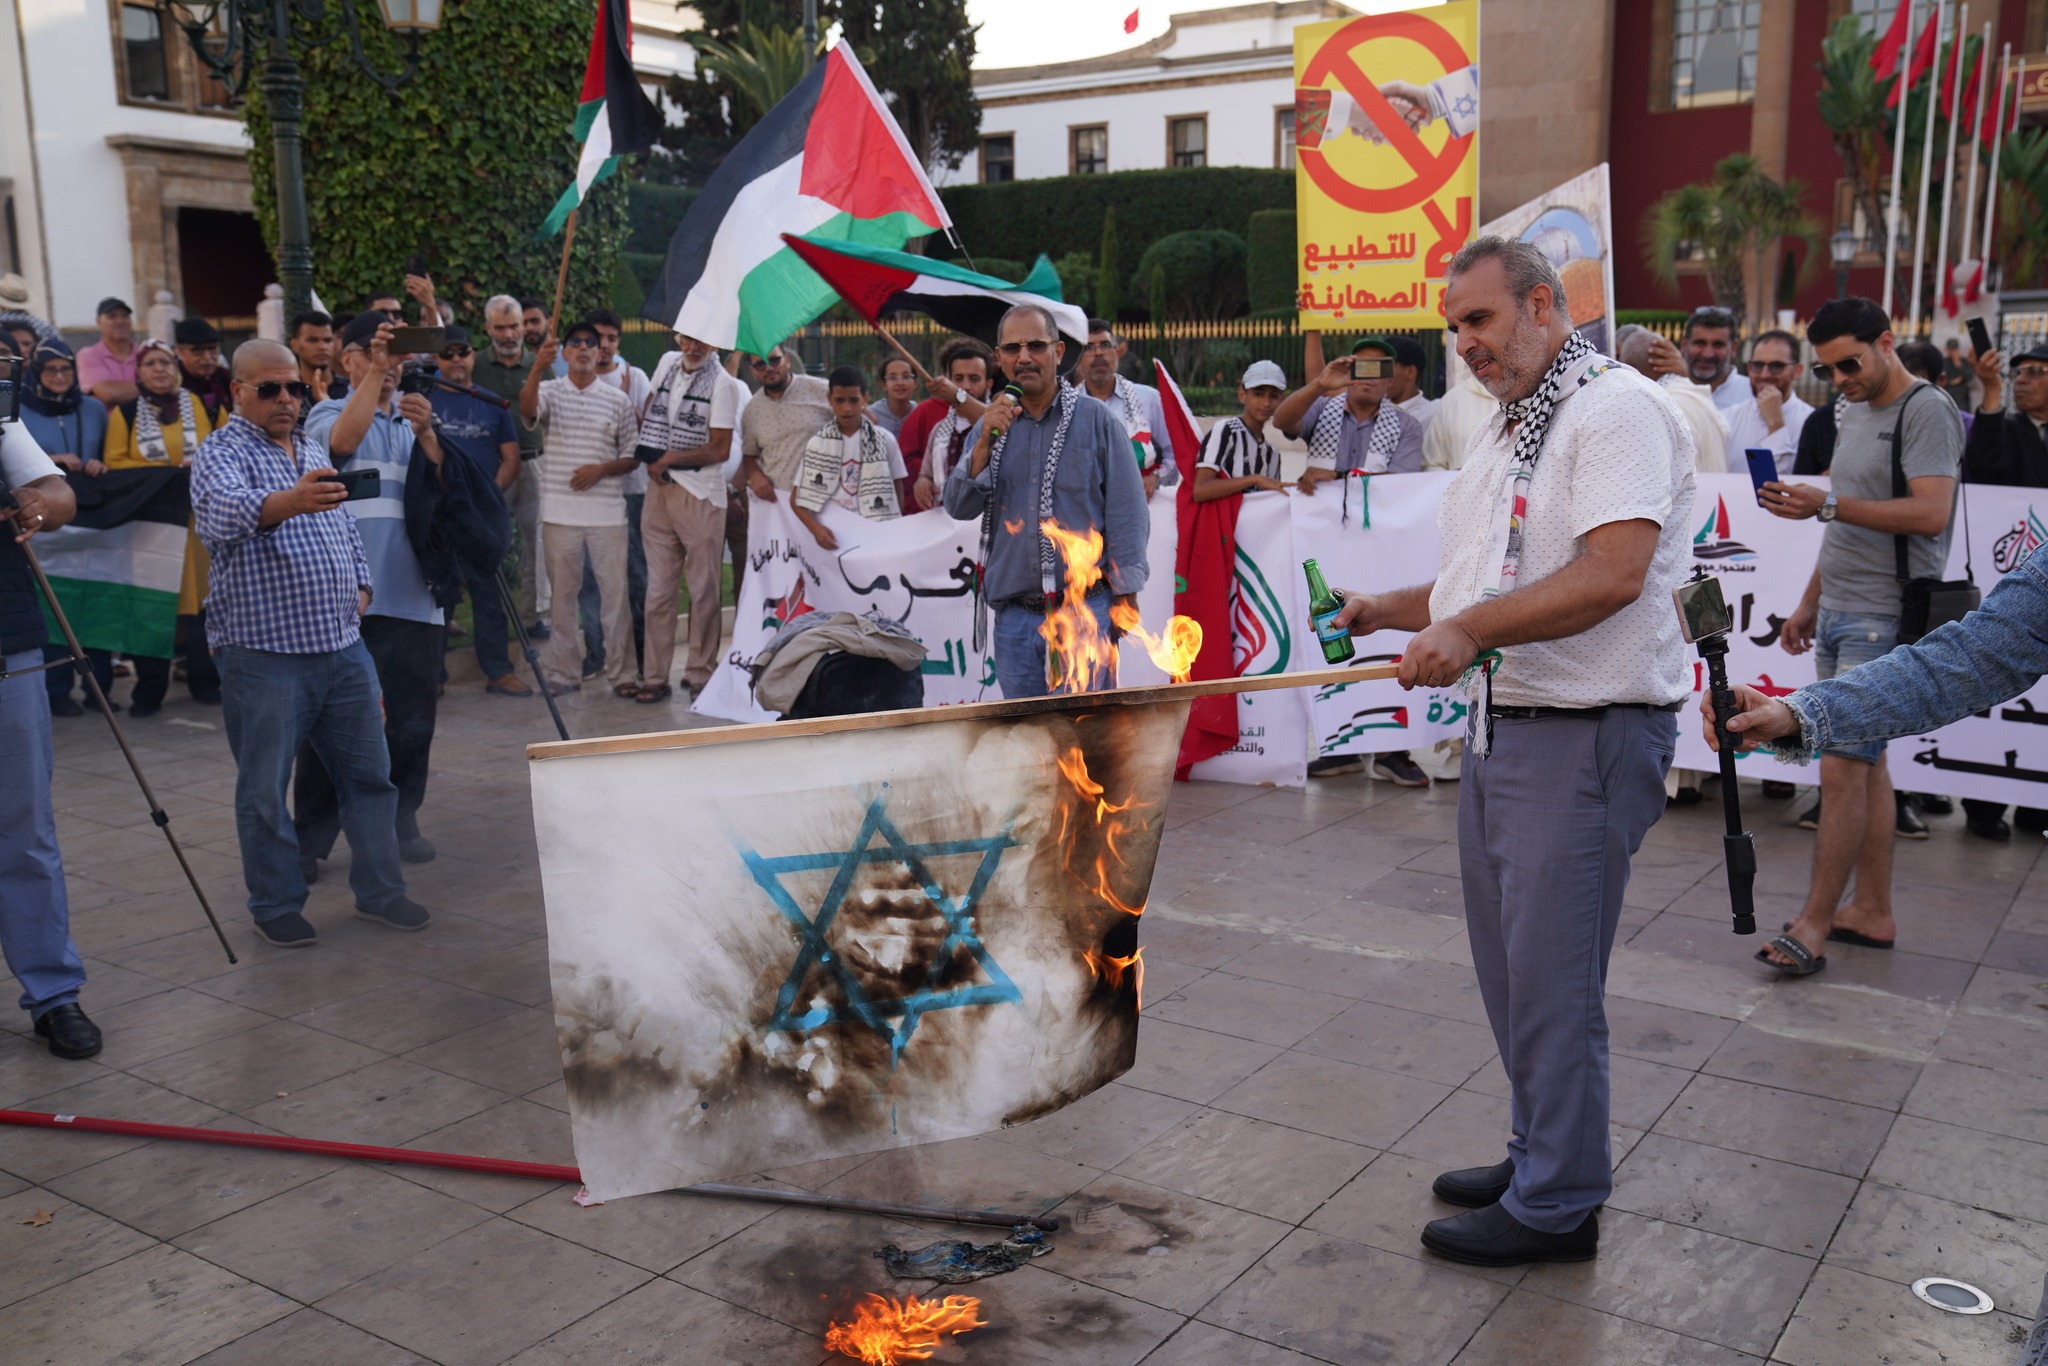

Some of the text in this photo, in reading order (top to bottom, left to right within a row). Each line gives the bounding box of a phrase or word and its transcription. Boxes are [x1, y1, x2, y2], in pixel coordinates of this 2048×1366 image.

[1304, 233, 1416, 271] للتطبيع
[1302, 282, 1427, 321] الصهاينة
[1238, 725, 1265, 738] القد
